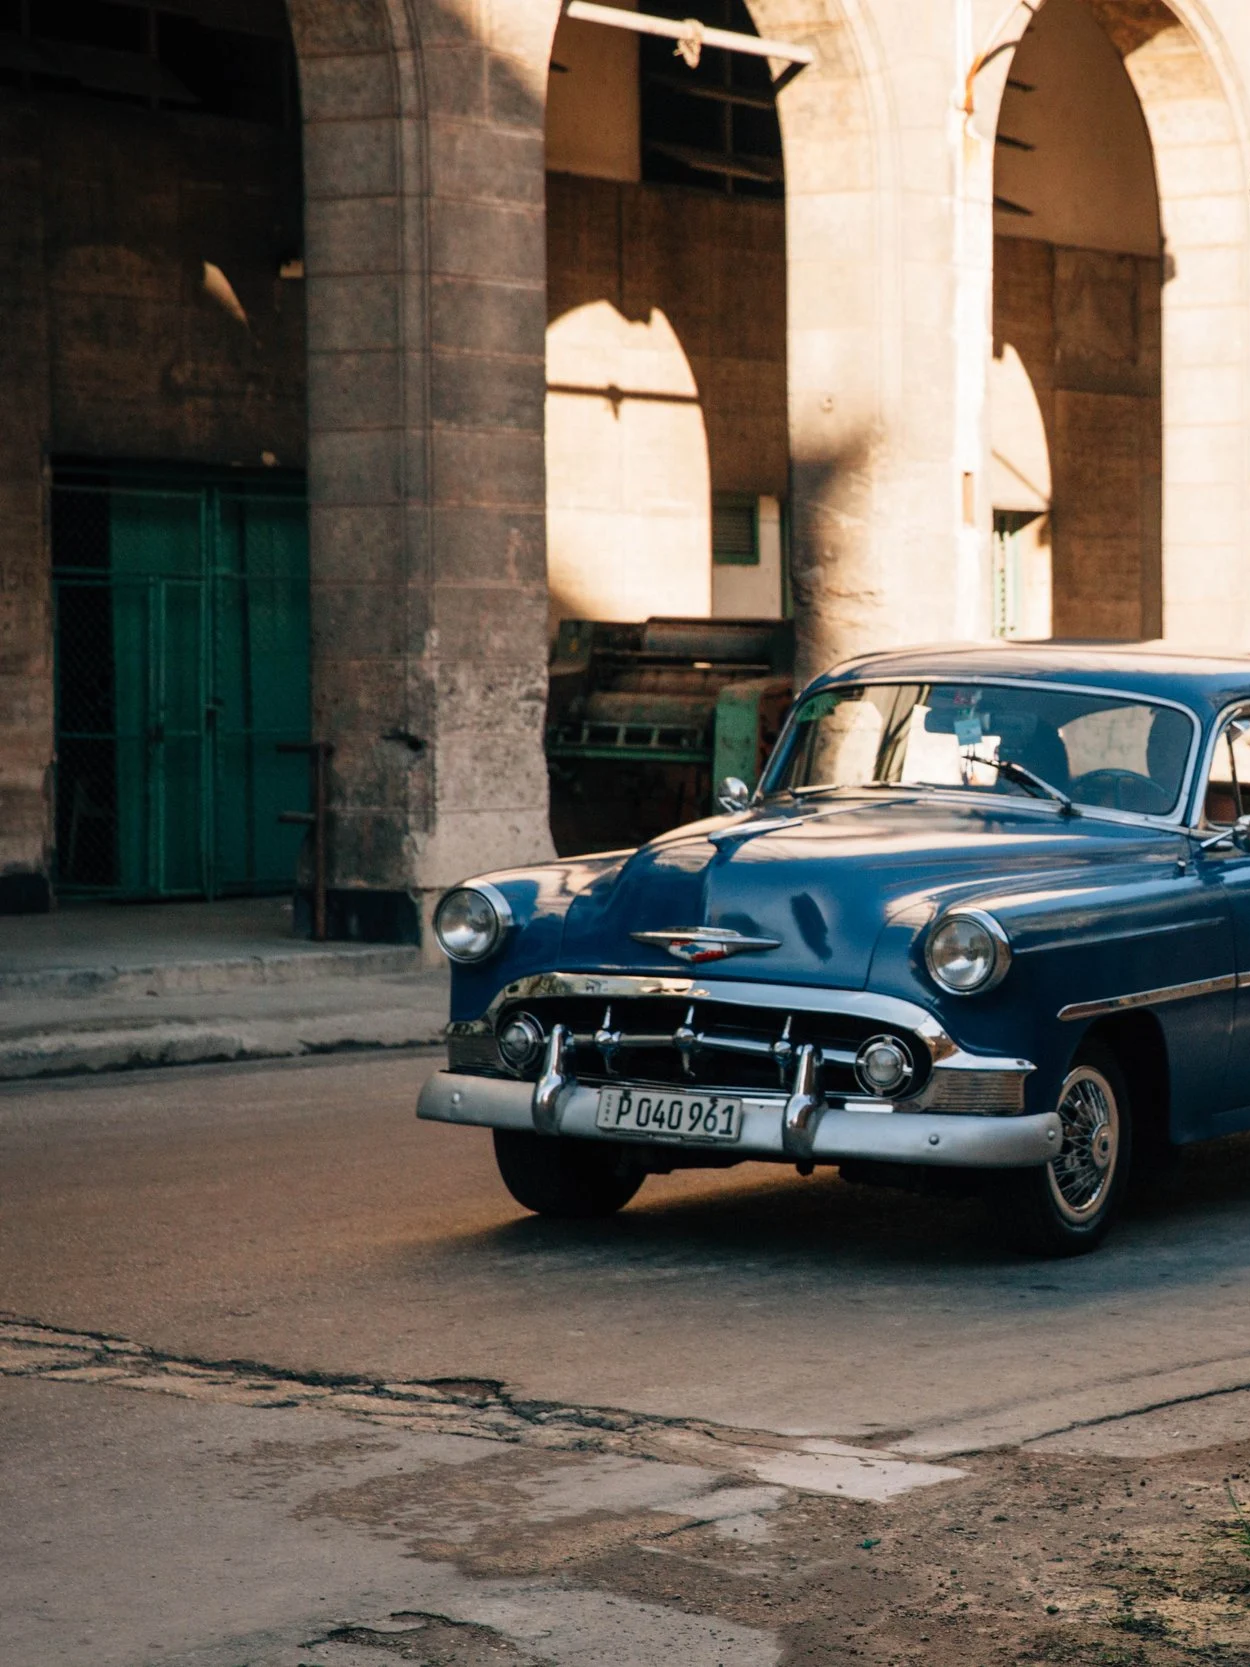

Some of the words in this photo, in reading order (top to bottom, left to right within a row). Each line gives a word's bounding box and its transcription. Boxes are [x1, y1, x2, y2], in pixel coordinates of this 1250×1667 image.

[615, 1095, 632, 1125] P
[636, 1098, 683, 1130] 040
[687, 1101, 735, 1135] 961
